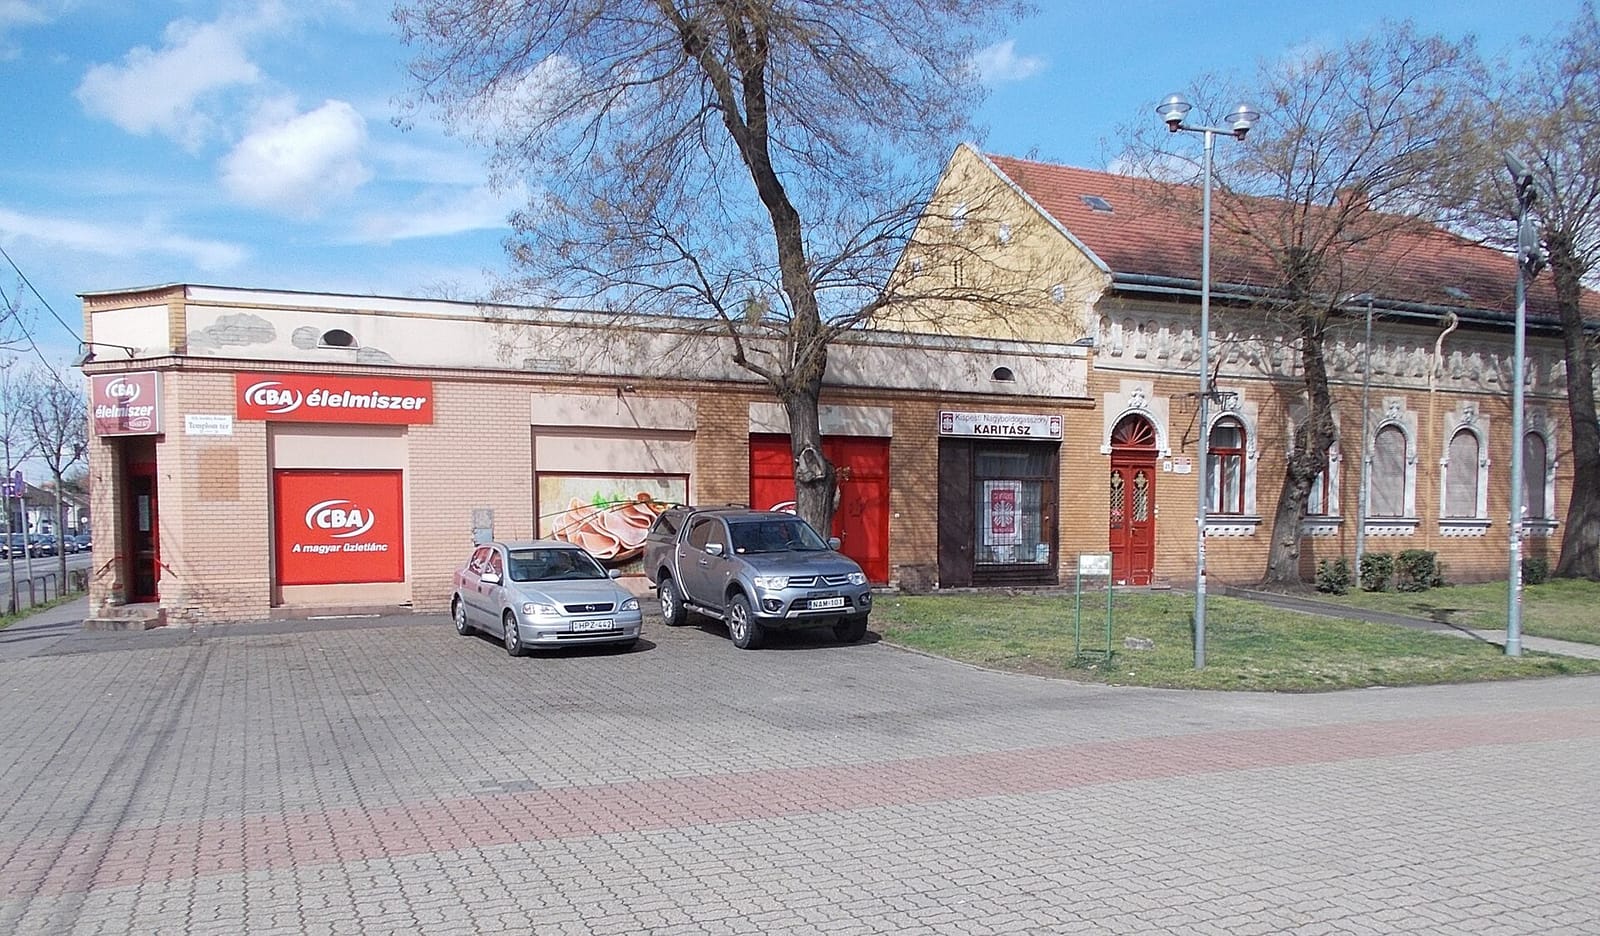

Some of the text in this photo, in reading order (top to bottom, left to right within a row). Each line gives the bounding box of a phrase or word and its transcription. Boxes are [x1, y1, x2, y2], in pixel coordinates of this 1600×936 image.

[254, 388, 426, 410] CBA élelmiszer
[95, 404, 154, 418] élelmiszer
[974, 423, 1031, 435] KARITÁSZ
[316, 509, 364, 529] CBA
[292, 543, 388, 554] A magyar üzletlánc
